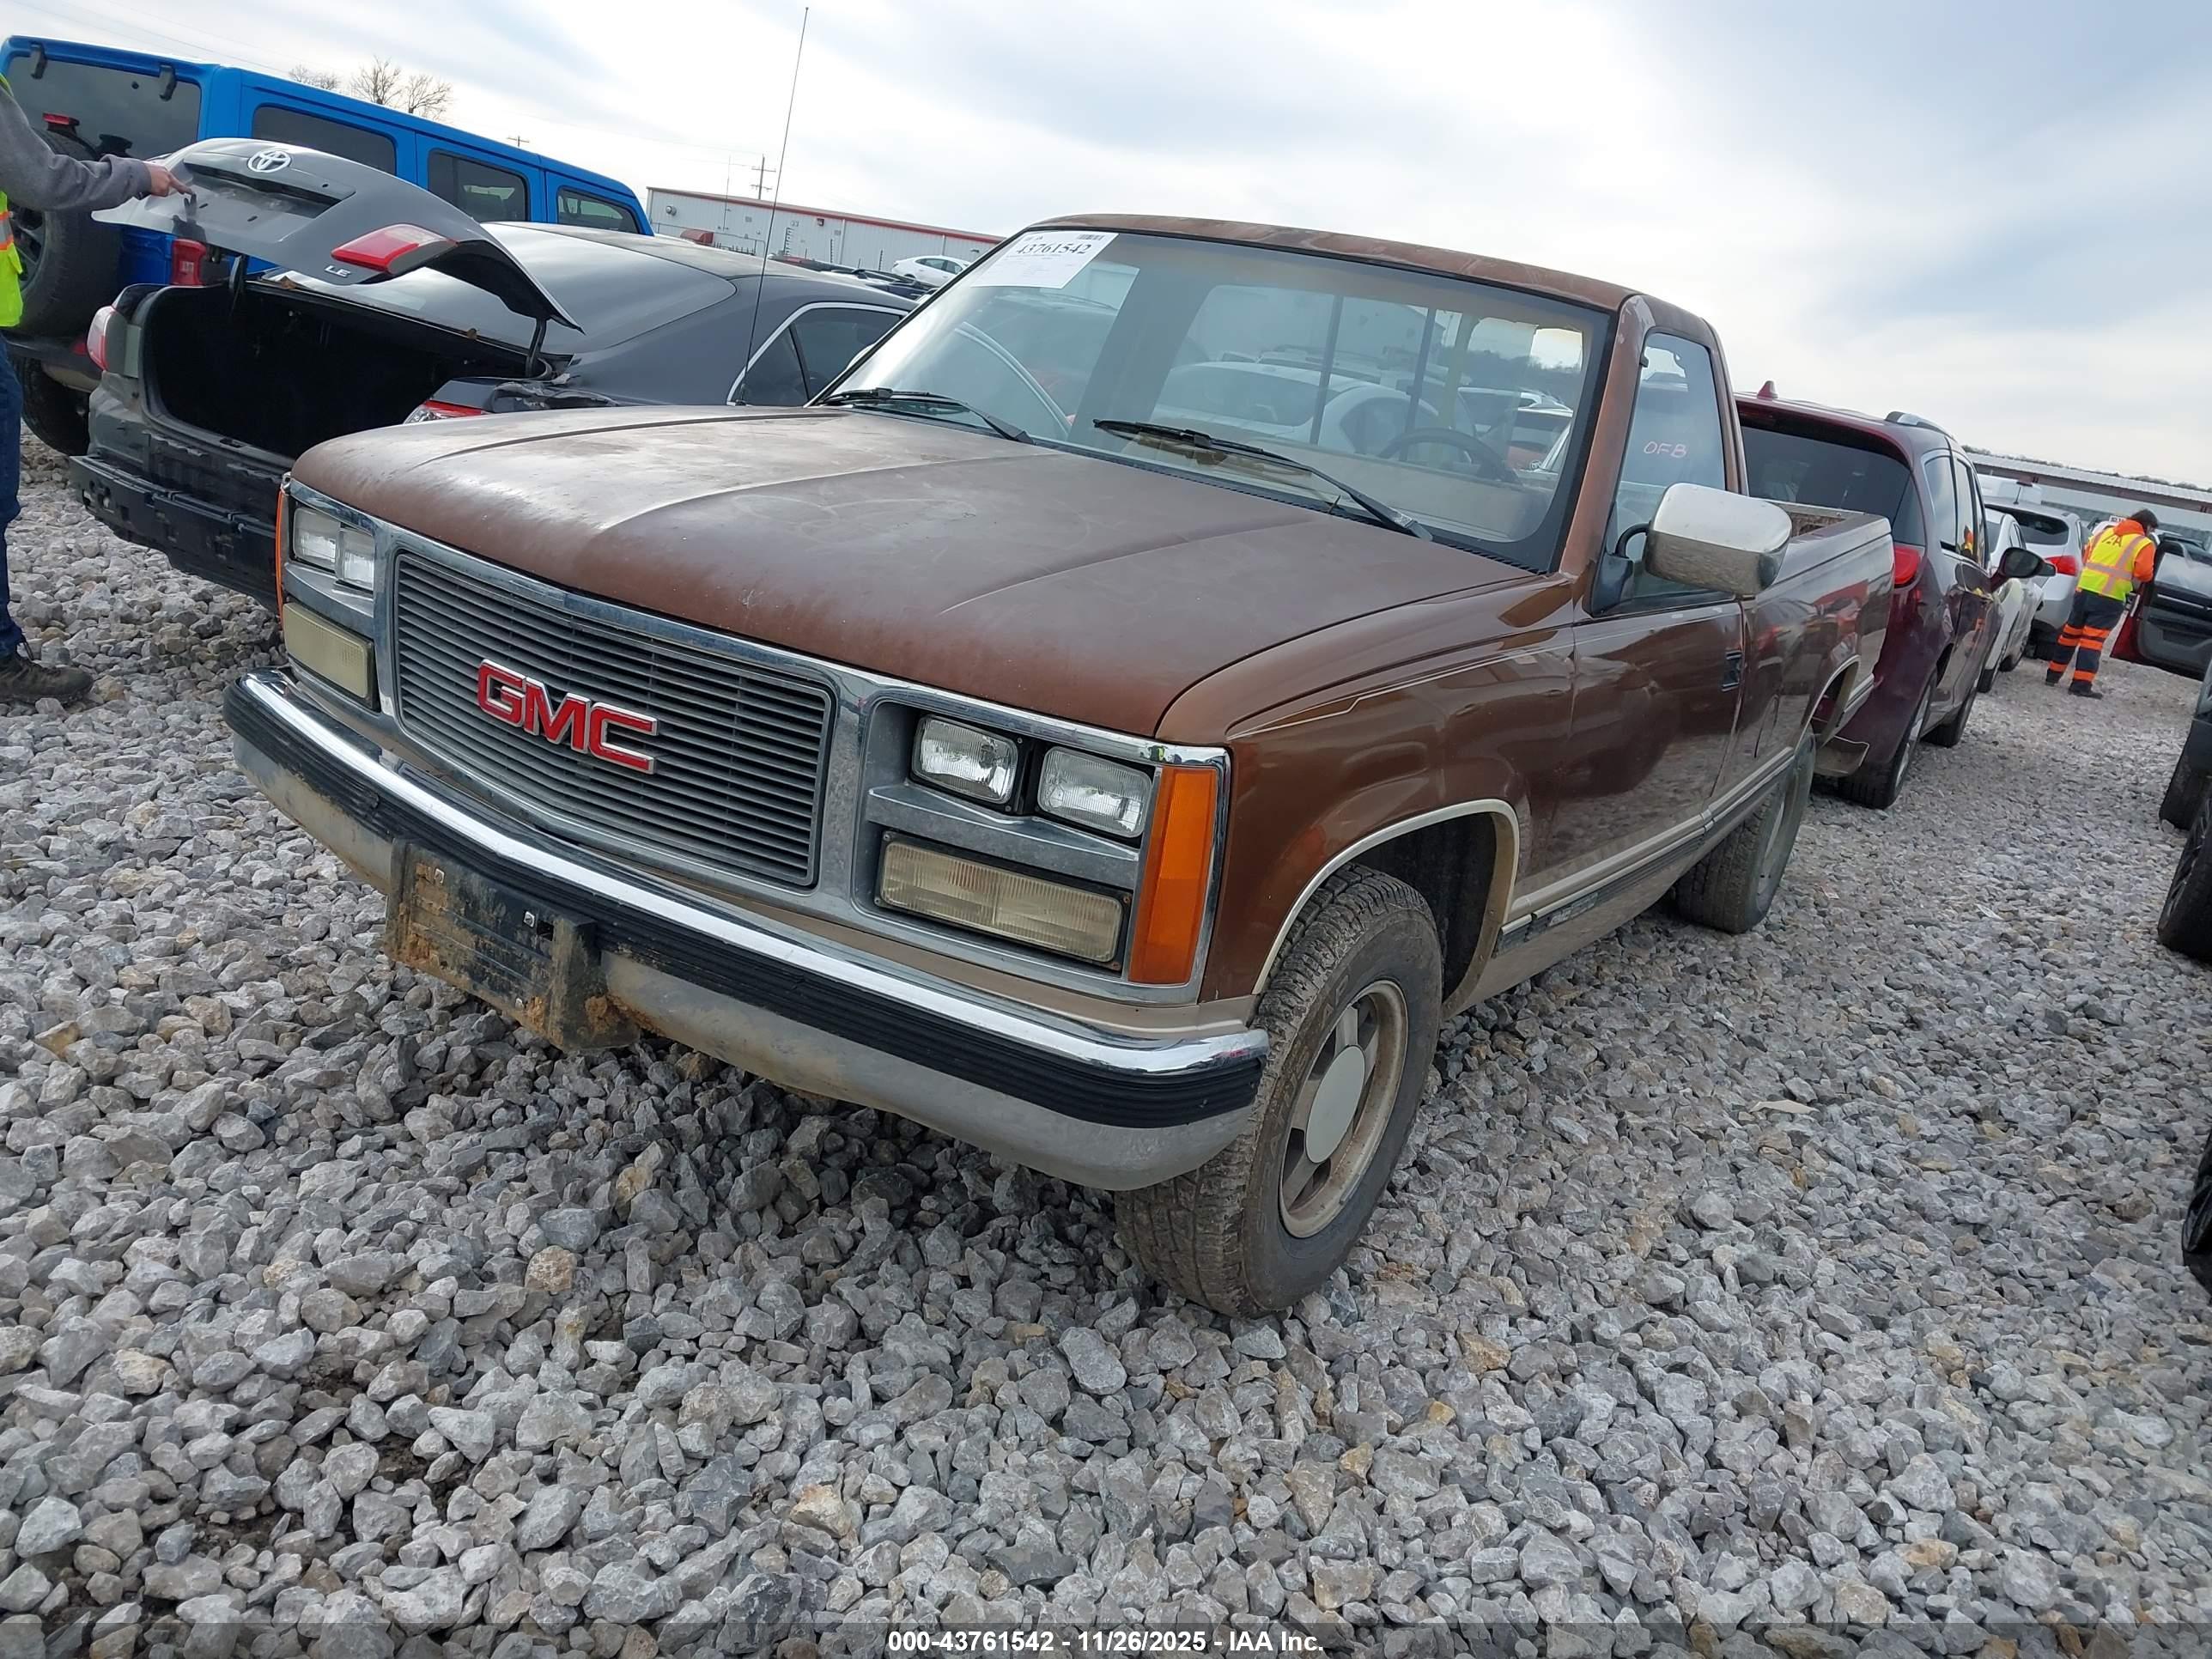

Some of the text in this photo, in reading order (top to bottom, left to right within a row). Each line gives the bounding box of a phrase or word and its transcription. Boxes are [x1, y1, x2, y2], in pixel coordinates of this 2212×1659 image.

[1017, 243, 1092, 254] 43761542
[325, 264, 351, 277] LE
[1644, 441, 1687, 459] OFB
[477, 659, 659, 775] GMC
